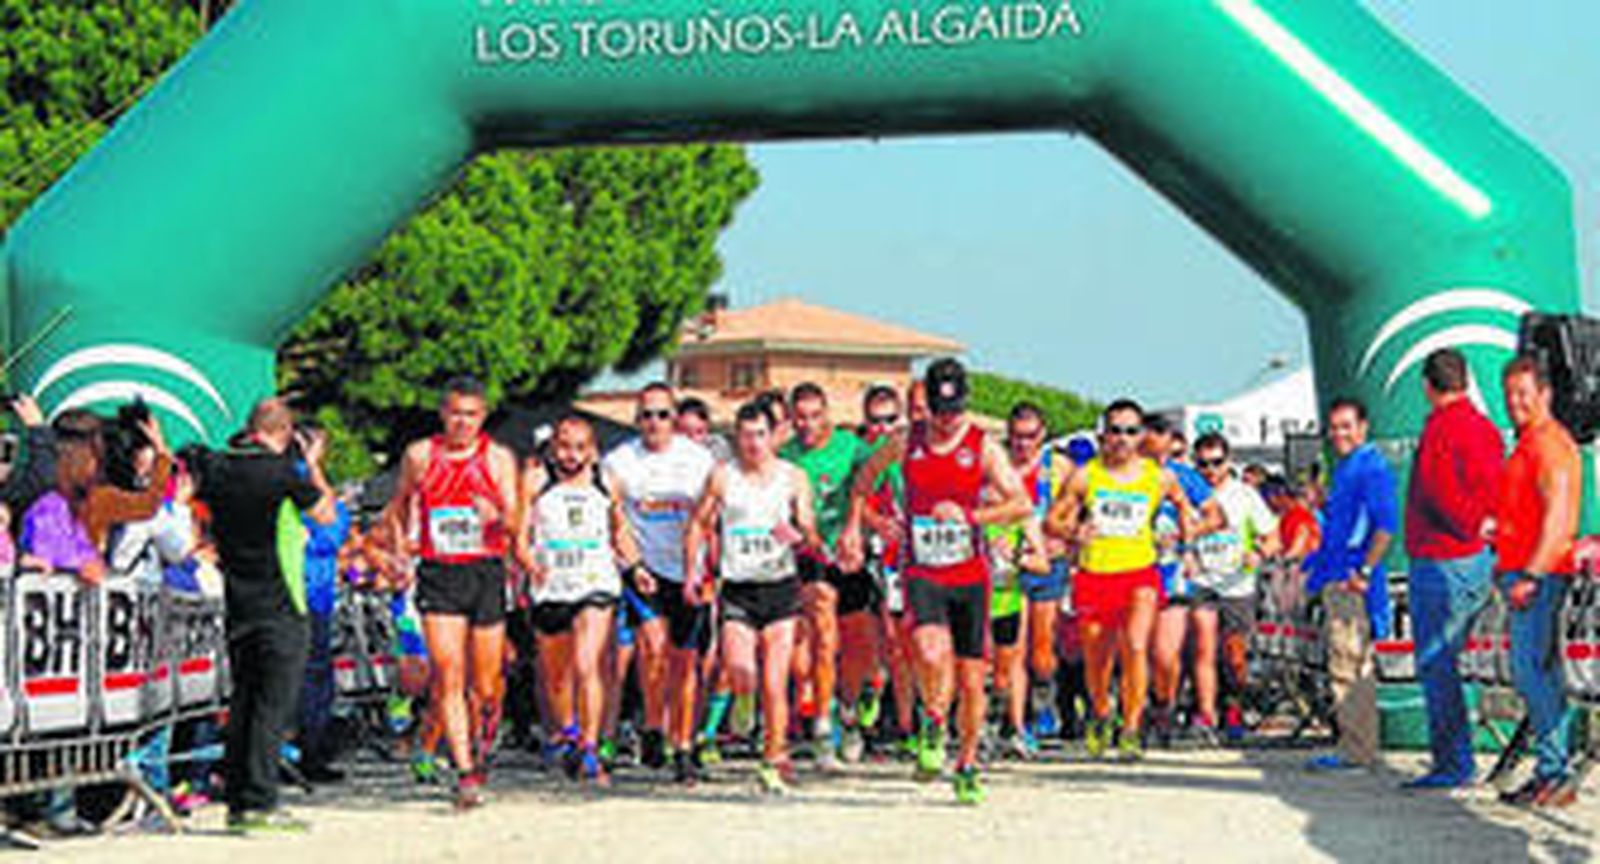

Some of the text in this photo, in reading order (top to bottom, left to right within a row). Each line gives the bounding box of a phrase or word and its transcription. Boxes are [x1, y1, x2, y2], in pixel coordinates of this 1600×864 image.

[476, 23, 561, 61] LOS
[874, 0, 1081, 46] ALGAIDA
[24, 591, 81, 674] BH
